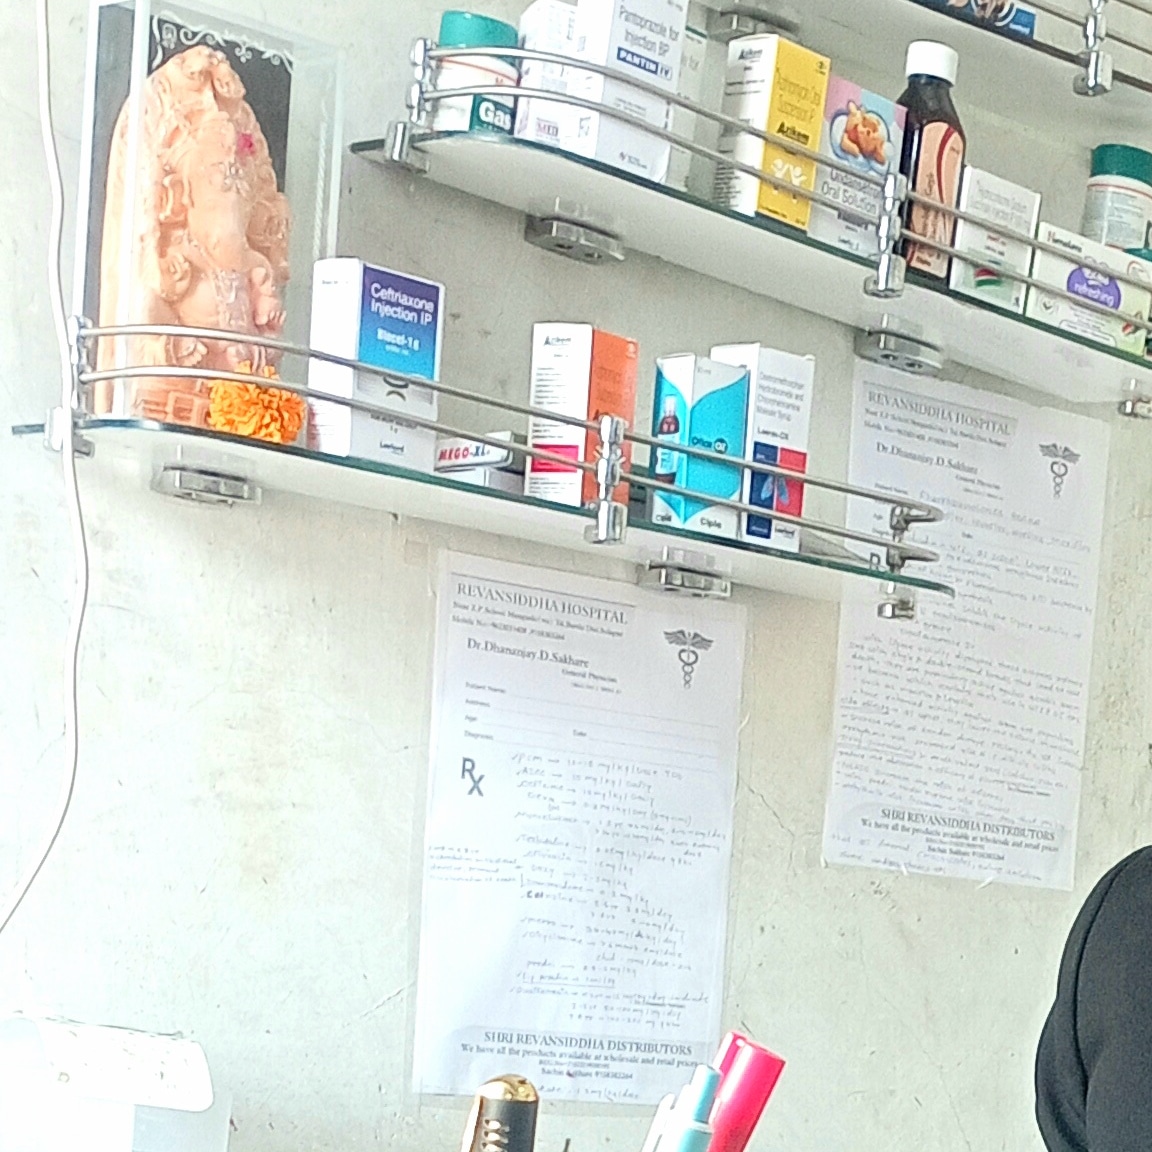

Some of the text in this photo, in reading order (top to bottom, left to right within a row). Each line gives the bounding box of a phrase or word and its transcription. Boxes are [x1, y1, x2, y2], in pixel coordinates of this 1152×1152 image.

[371, 299, 432, 326] Injection IP
[457, 583, 559, 613] REVANSIDDHA
[561, 602, 628, 625] HOSPITAL
[484, 1031, 693, 1056] SHRI REVANSIDDHA DISTRIBUTORS
